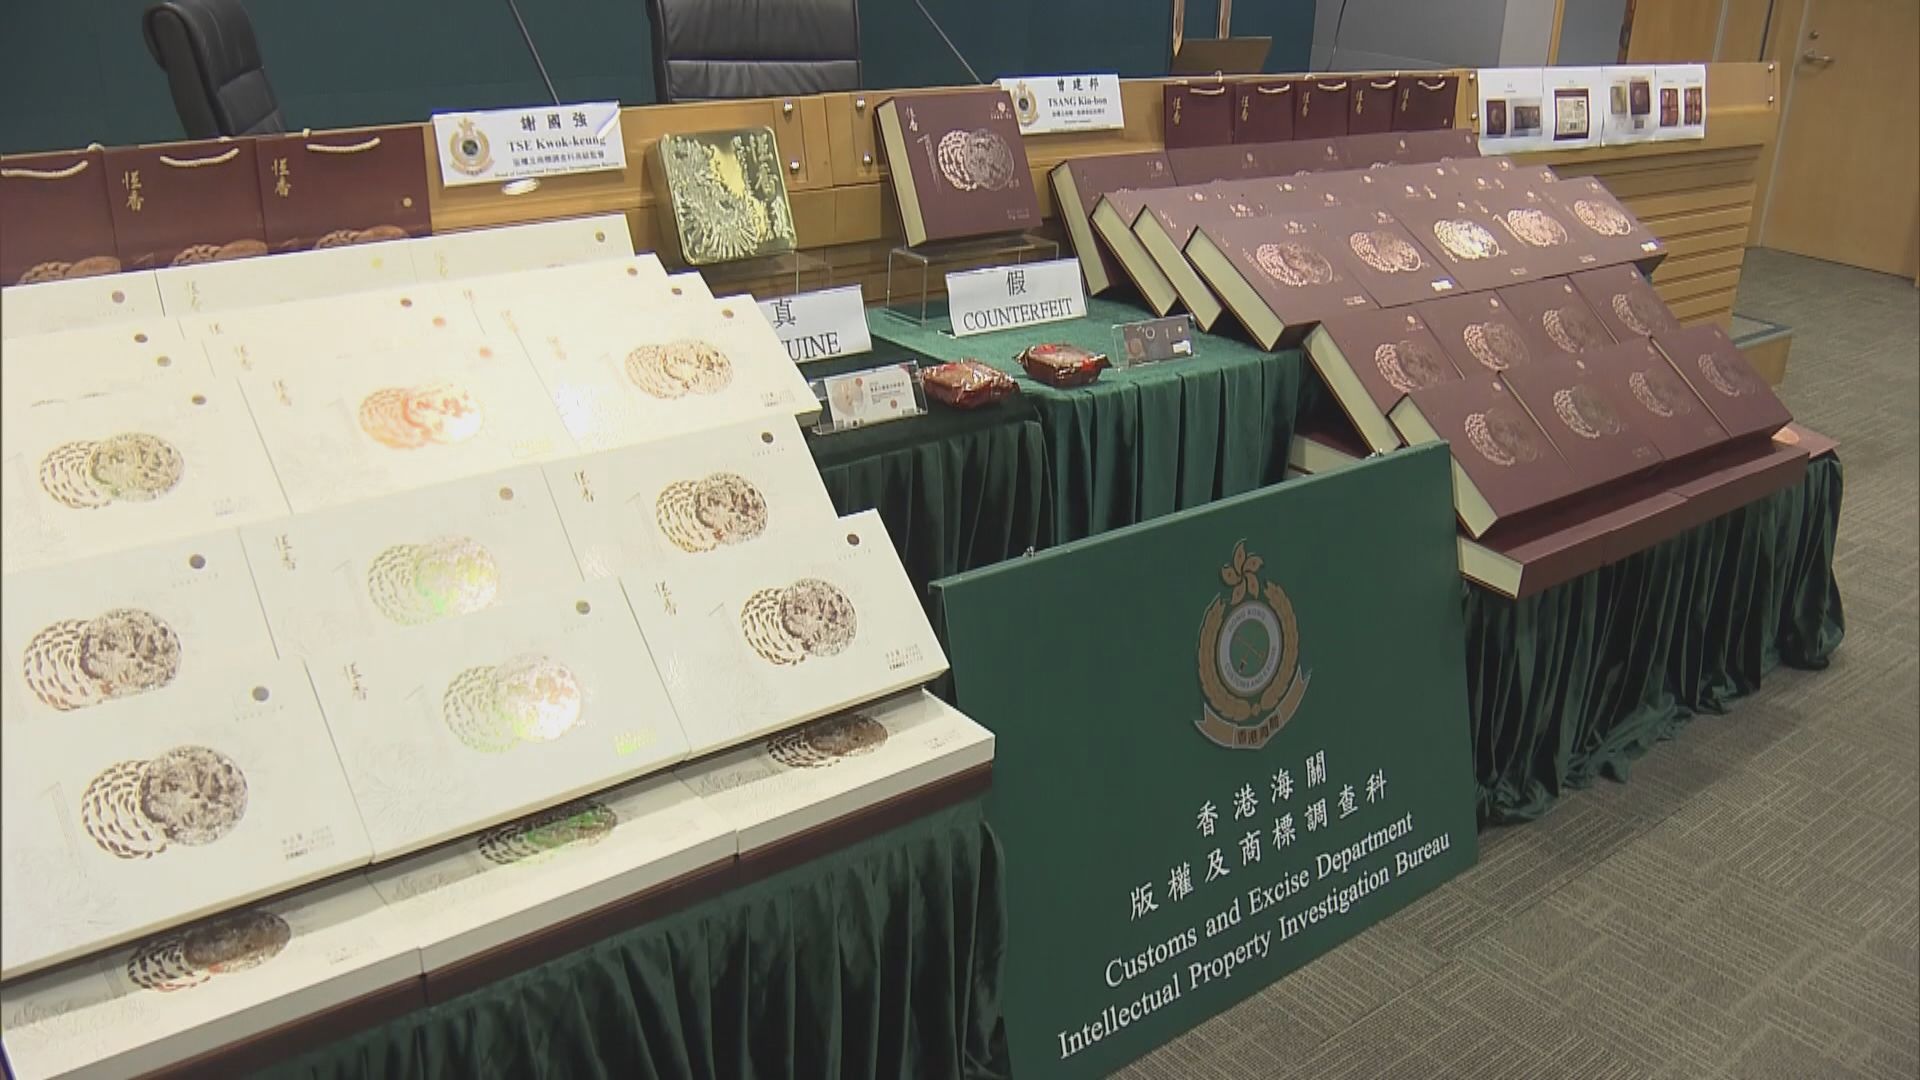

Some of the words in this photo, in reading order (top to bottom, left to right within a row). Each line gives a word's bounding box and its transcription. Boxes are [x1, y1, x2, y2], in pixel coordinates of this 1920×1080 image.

[508, 140, 533, 153] TSE
[536, 135, 607, 151] Kwok-keung
[1006, 269, 1026, 297] 假
[770, 299, 797, 329] 真
[963, 298, 1073, 331] COUNTERFEIT
[781, 331, 841, 361] UINE
[1196, 750, 1327, 838] 香港海關
[1130, 768, 1387, 921] 版權及商標調查科
[1105, 924, 1198, 988] Customs
[1205, 898, 1241, 938] and
[1248, 870, 1310, 917] Excise
[1316, 811, 1413, 880] Department
[1058, 973, 1182, 1059] Intellectual
[1189, 928, 1271, 991] Property
[1279, 864, 1390, 942] Investigation
[1395, 832, 1451, 876] Bureau
